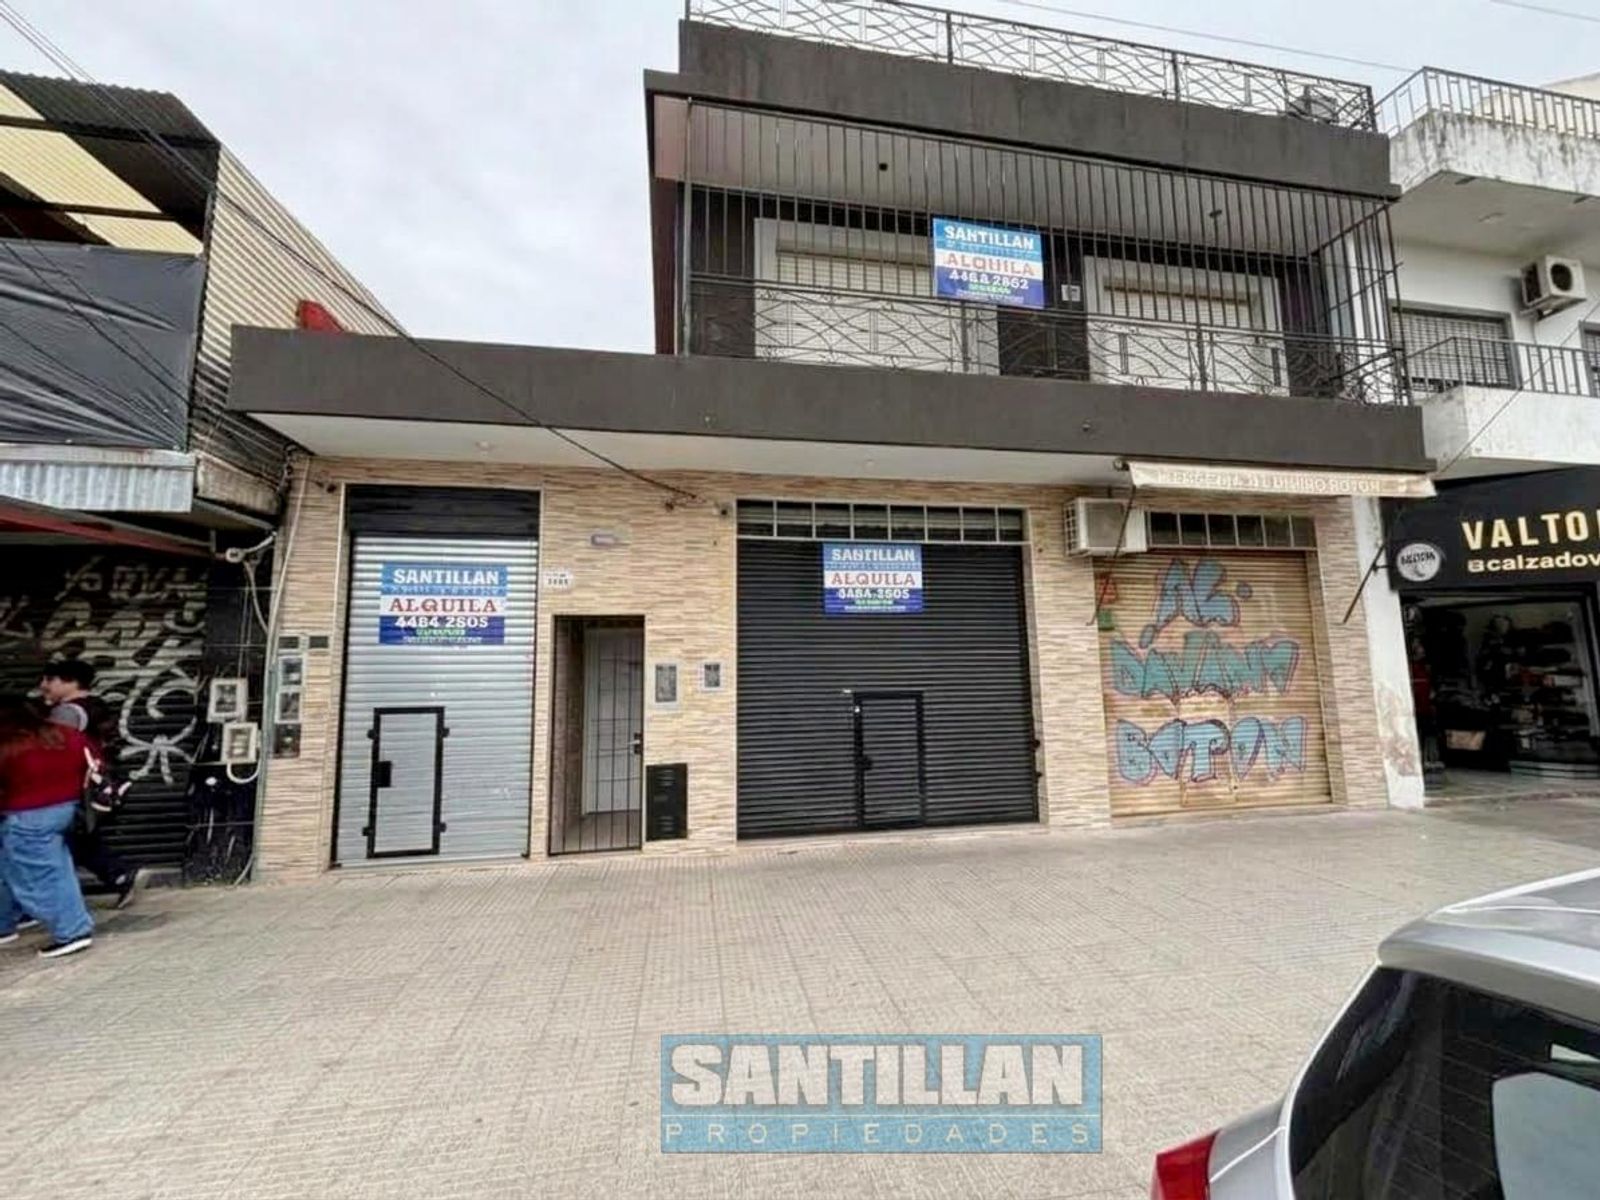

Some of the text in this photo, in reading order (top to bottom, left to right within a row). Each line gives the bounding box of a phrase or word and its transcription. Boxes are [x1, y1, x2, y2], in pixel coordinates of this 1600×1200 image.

[944, 225, 1034, 250] SANTILLAN
[947, 252, 1034, 276] ALQUILA
[1461, 508, 1600, 550] VALTO
[832, 548, 915, 561] SANTILLAN
[393, 568, 499, 585] SANTILLAN
[831, 572, 916, 586] ALQUILA
[389, 598, 497, 613] ALQUILA
